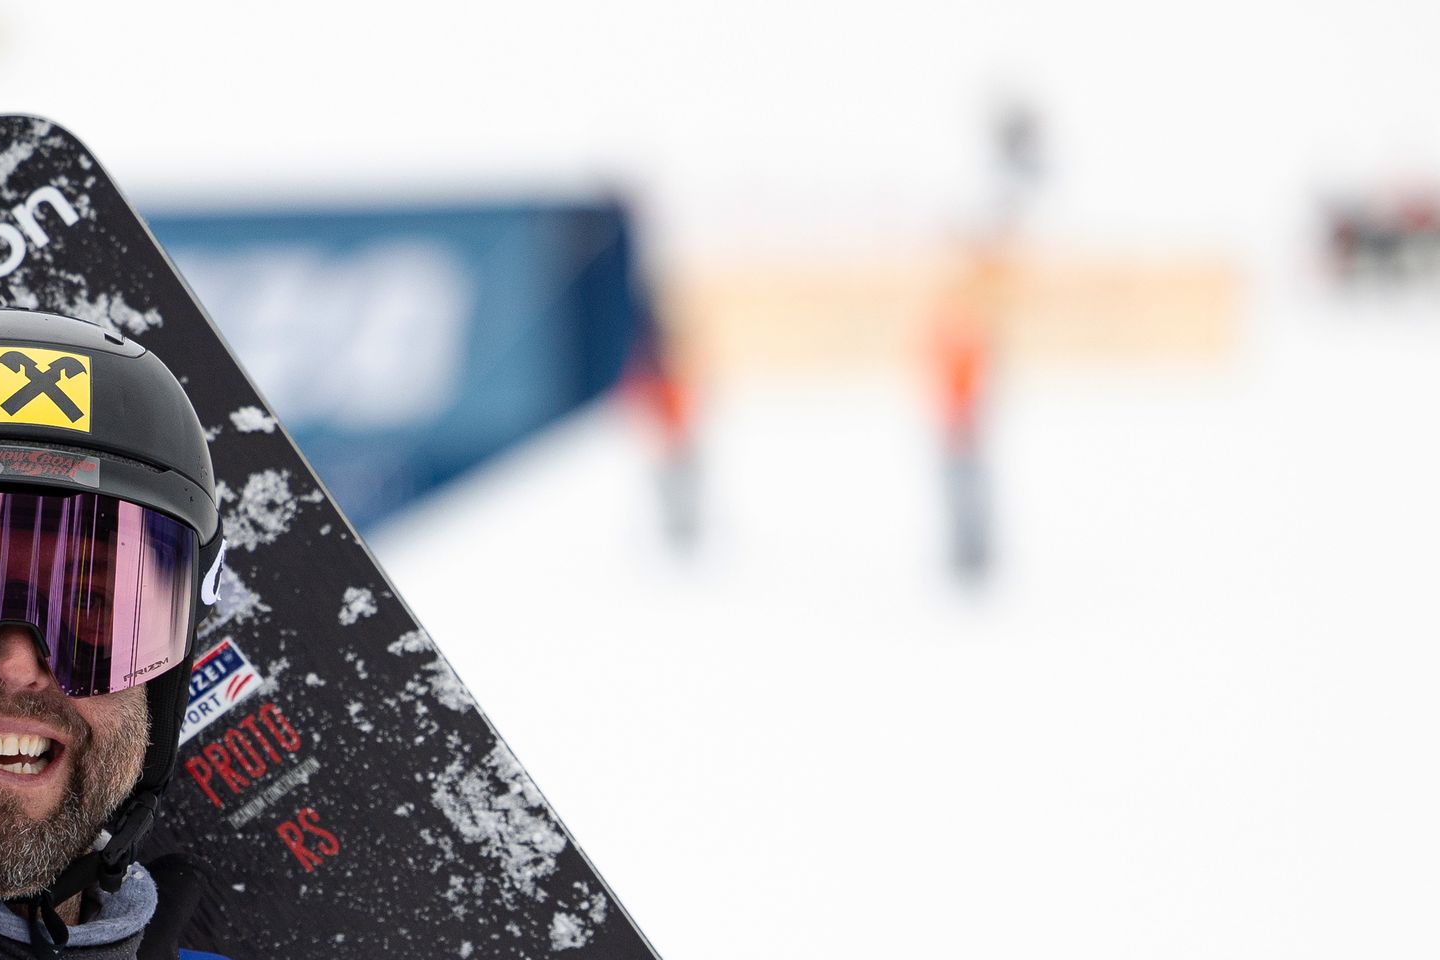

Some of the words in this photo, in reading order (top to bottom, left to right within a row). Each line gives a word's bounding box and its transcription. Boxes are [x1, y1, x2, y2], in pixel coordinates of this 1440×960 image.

[123, 656, 169, 682] PRIZM
[189, 660, 227, 697] IZEI
[180, 693, 221, 733] PORT
[184, 703, 302, 808] PROTO
[276, 807, 340, 873] RS
